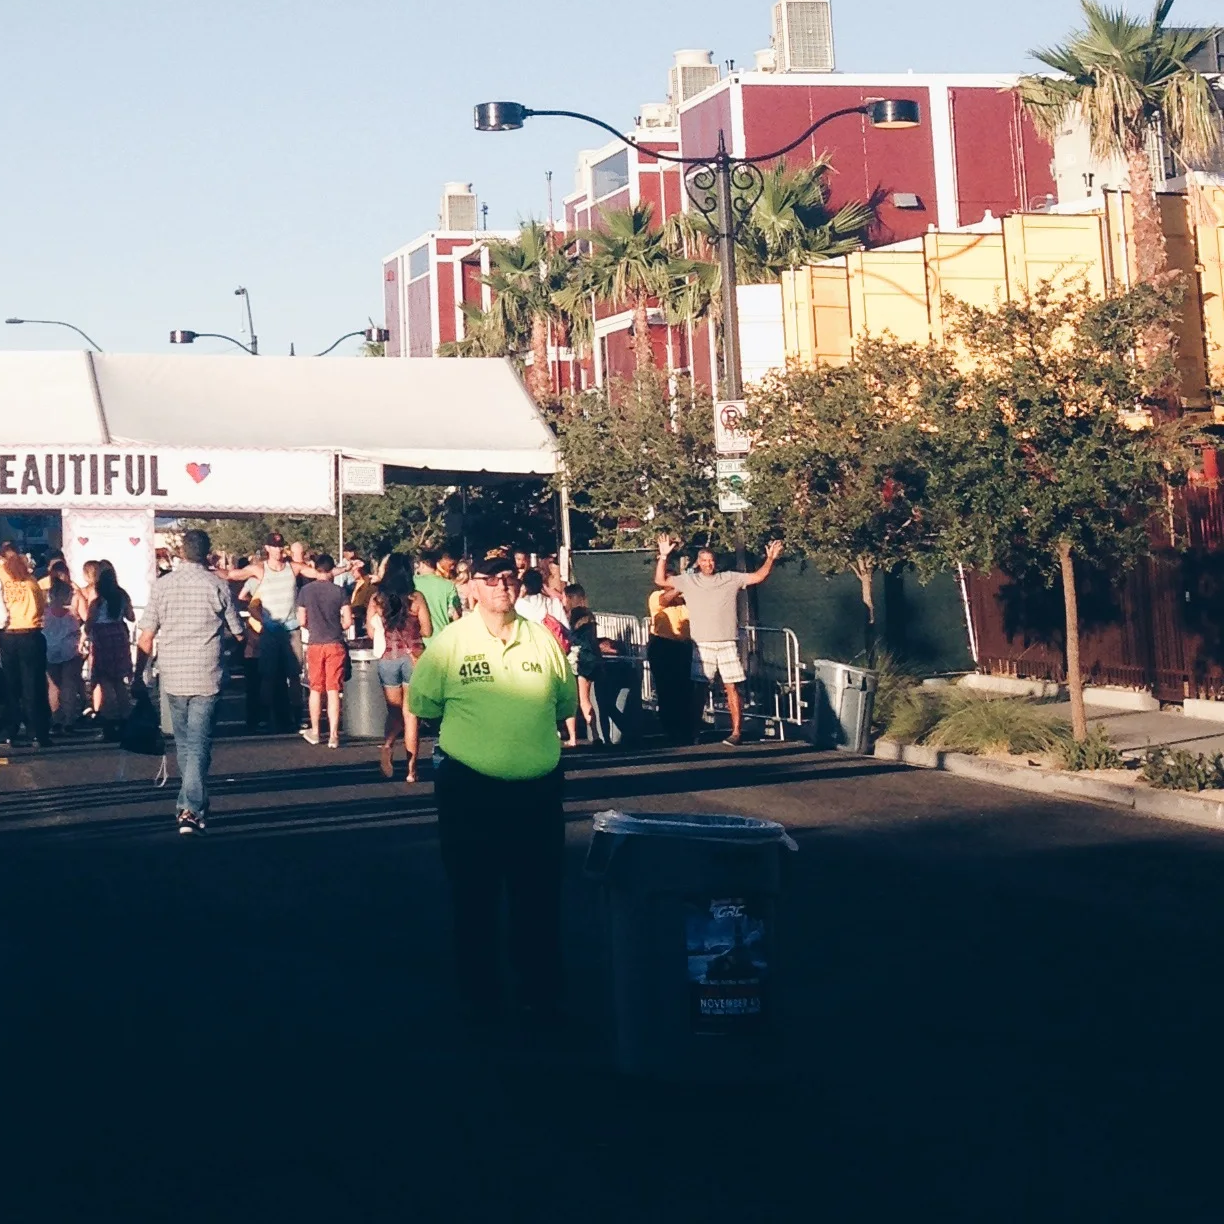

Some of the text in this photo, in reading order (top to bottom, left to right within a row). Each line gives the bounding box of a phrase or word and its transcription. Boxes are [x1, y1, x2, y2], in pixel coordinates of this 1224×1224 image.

[464, 654, 485, 662] GUEST
[459, 661, 490, 677] 4149
[461, 676, 495, 686] SERVICES
